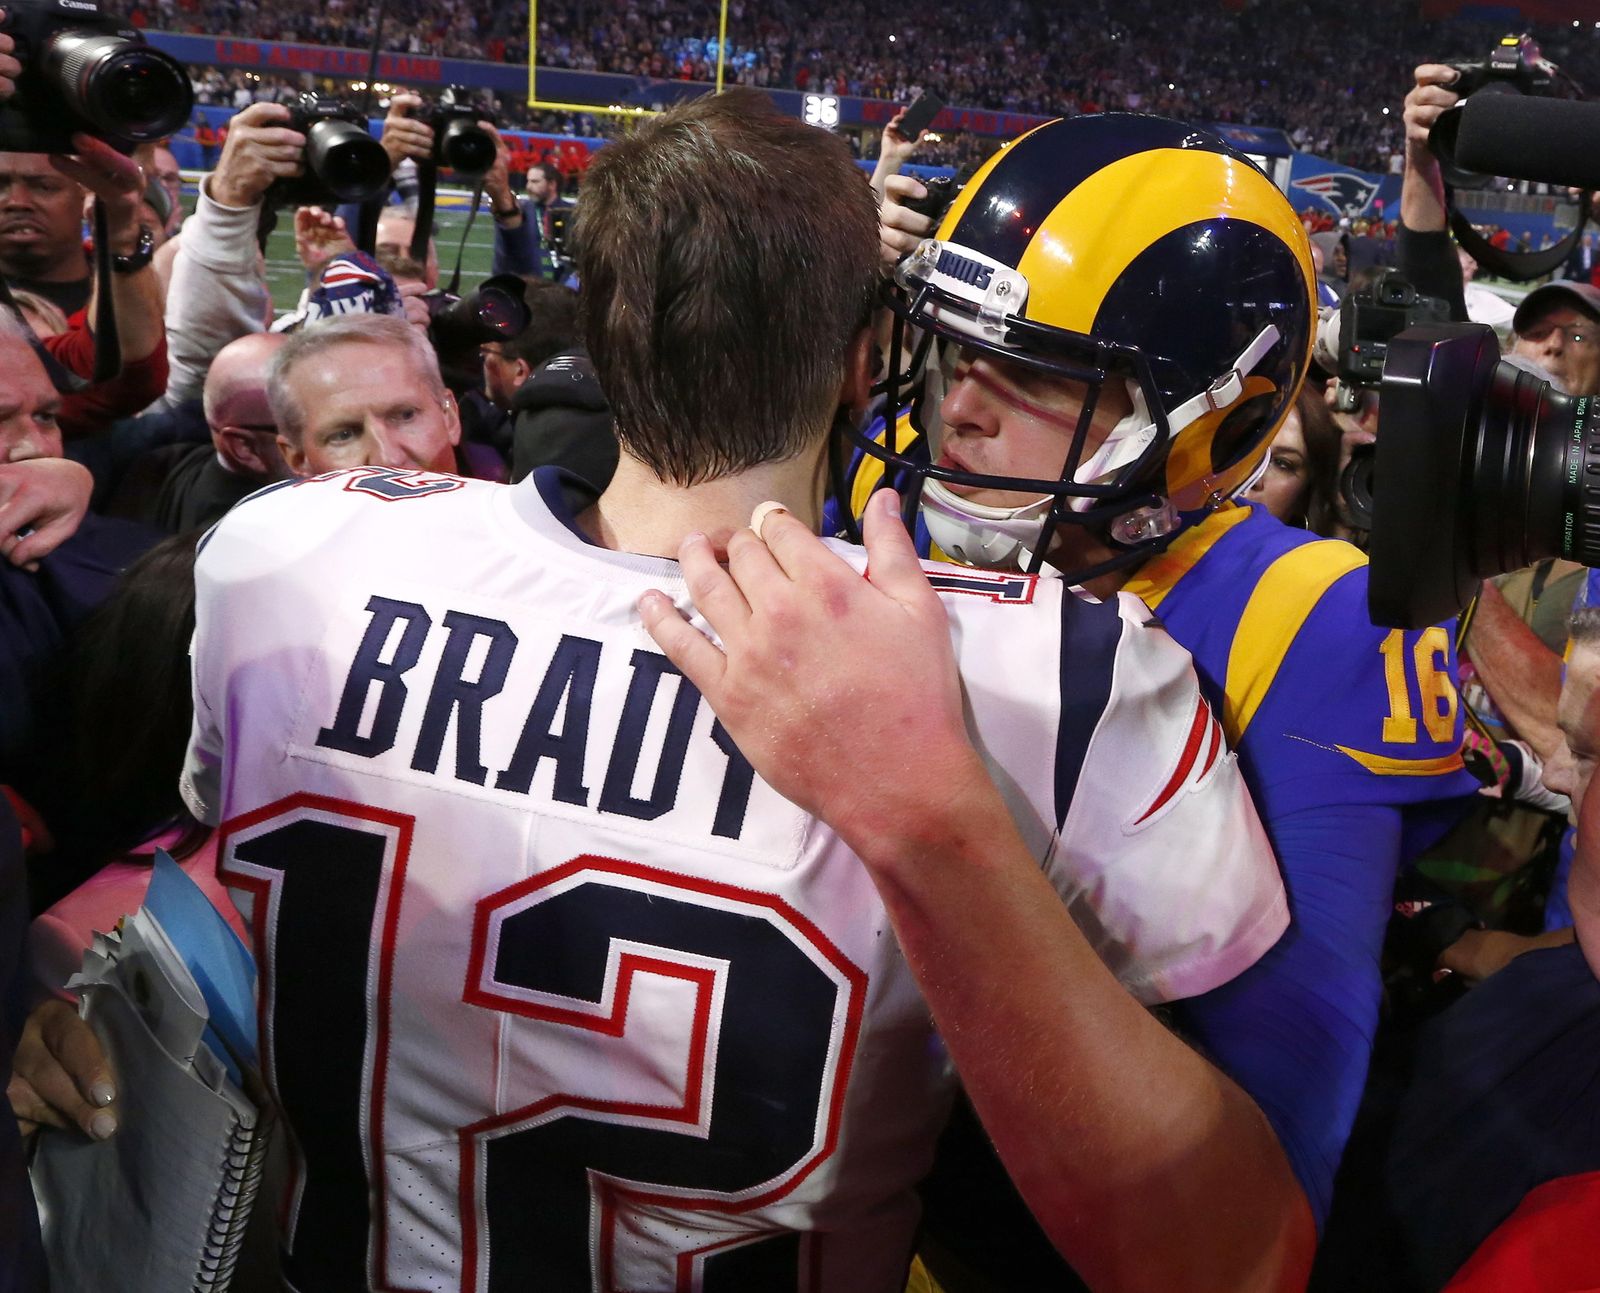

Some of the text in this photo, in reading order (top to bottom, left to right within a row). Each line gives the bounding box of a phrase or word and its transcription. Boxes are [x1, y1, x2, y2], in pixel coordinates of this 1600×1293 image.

[58, 0, 98, 12] Canon
[1490, 61, 1517, 70] Canon
[804, 95, 838, 125] 36
[1573, 419, 1583, 444] JAPAN
[1568, 459, 1579, 484] MADE
[1379, 625, 1458, 744] 16
[216, 791, 868, 1293] 12
